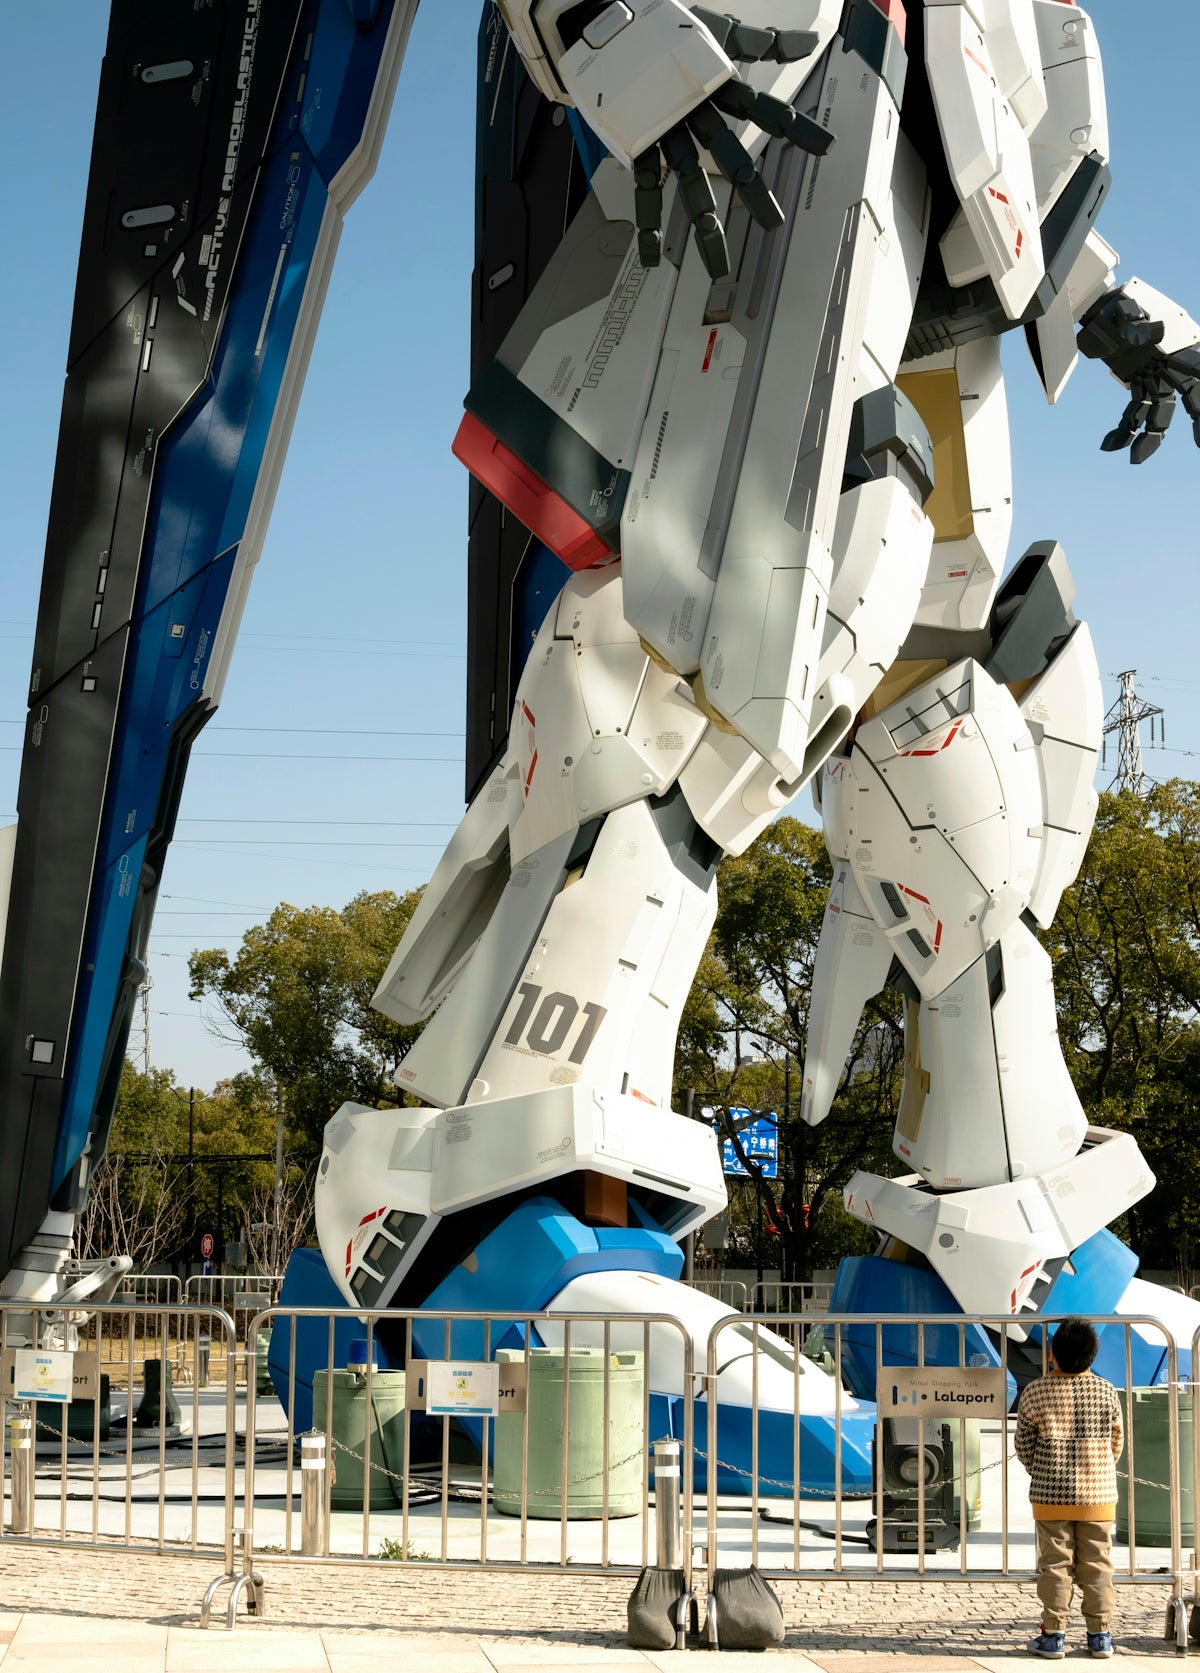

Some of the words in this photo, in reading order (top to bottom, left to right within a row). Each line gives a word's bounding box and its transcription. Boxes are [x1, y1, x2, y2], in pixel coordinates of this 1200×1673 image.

[280, 183, 295, 229] CAUTION
[205, 197, 230, 289] ACTIVE
[505, 982, 608, 1065] 101
[932, 1380, 961, 1388] Shopping
[934, 1391, 995, 1405] LaLaport
